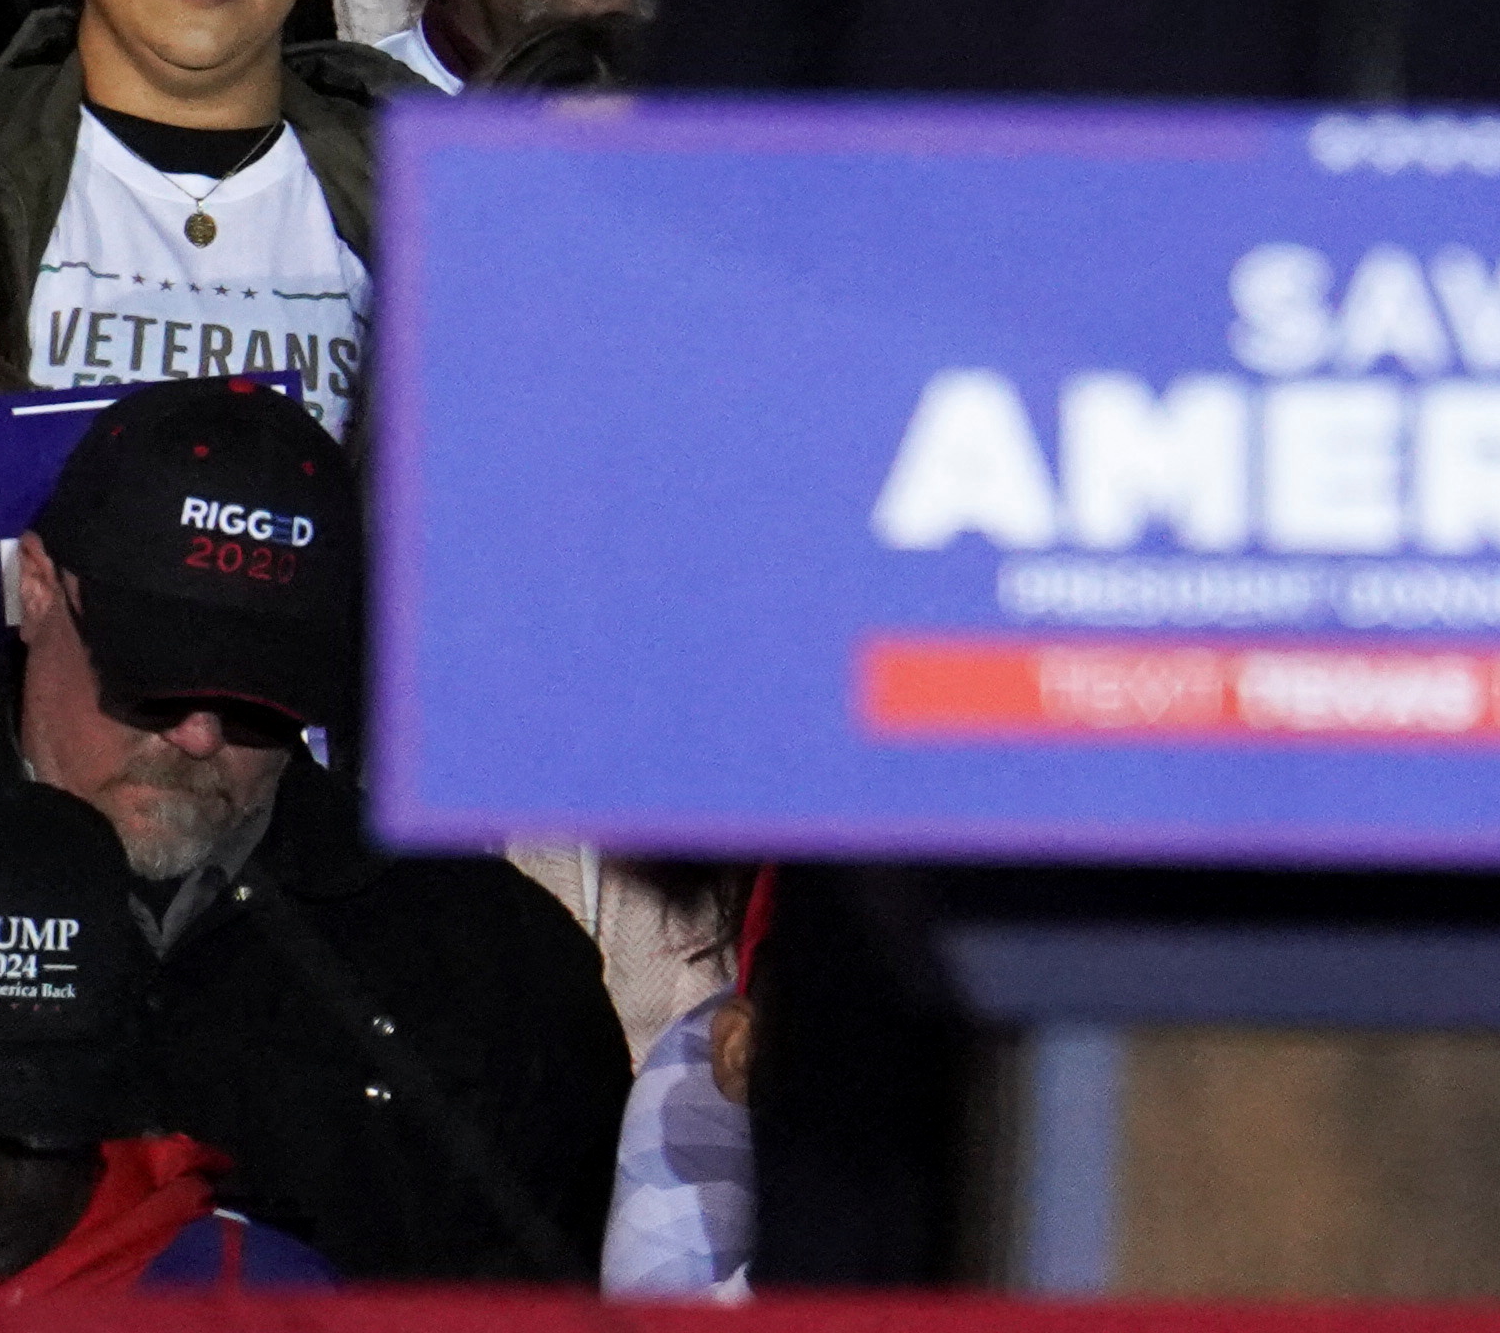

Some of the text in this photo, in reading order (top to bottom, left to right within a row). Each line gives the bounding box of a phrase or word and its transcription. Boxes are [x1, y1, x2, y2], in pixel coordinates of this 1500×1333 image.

[48, 310, 358, 399] VETERANS
[181, 496, 314, 547] RIGGED
[184, 536, 297, 585] 2020
[40, 982, 76, 1000] Back
